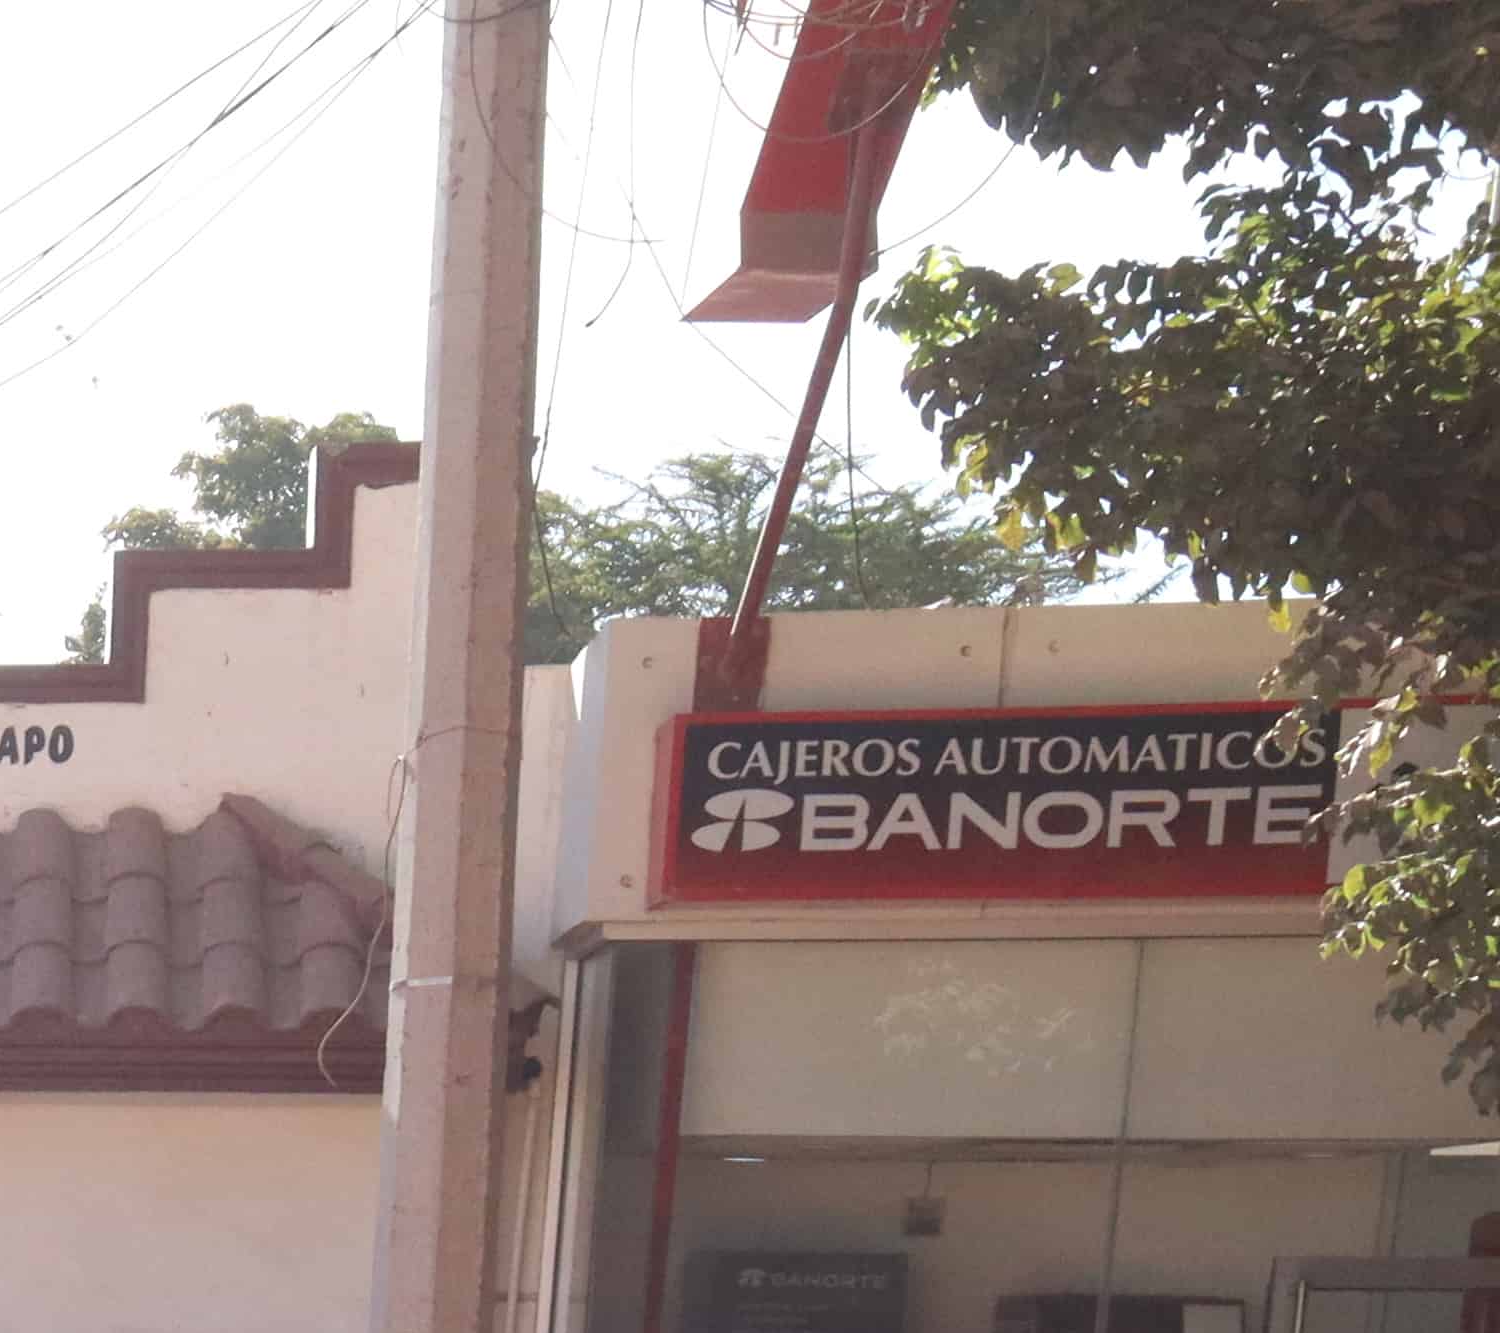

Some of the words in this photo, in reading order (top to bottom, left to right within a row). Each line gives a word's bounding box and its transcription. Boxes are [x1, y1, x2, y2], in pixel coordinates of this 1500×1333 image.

[707, 737, 921, 786] CAJEROS
[933, 728, 1328, 777] AUTOMATICOS
[800, 783, 1324, 852] BANORTE
